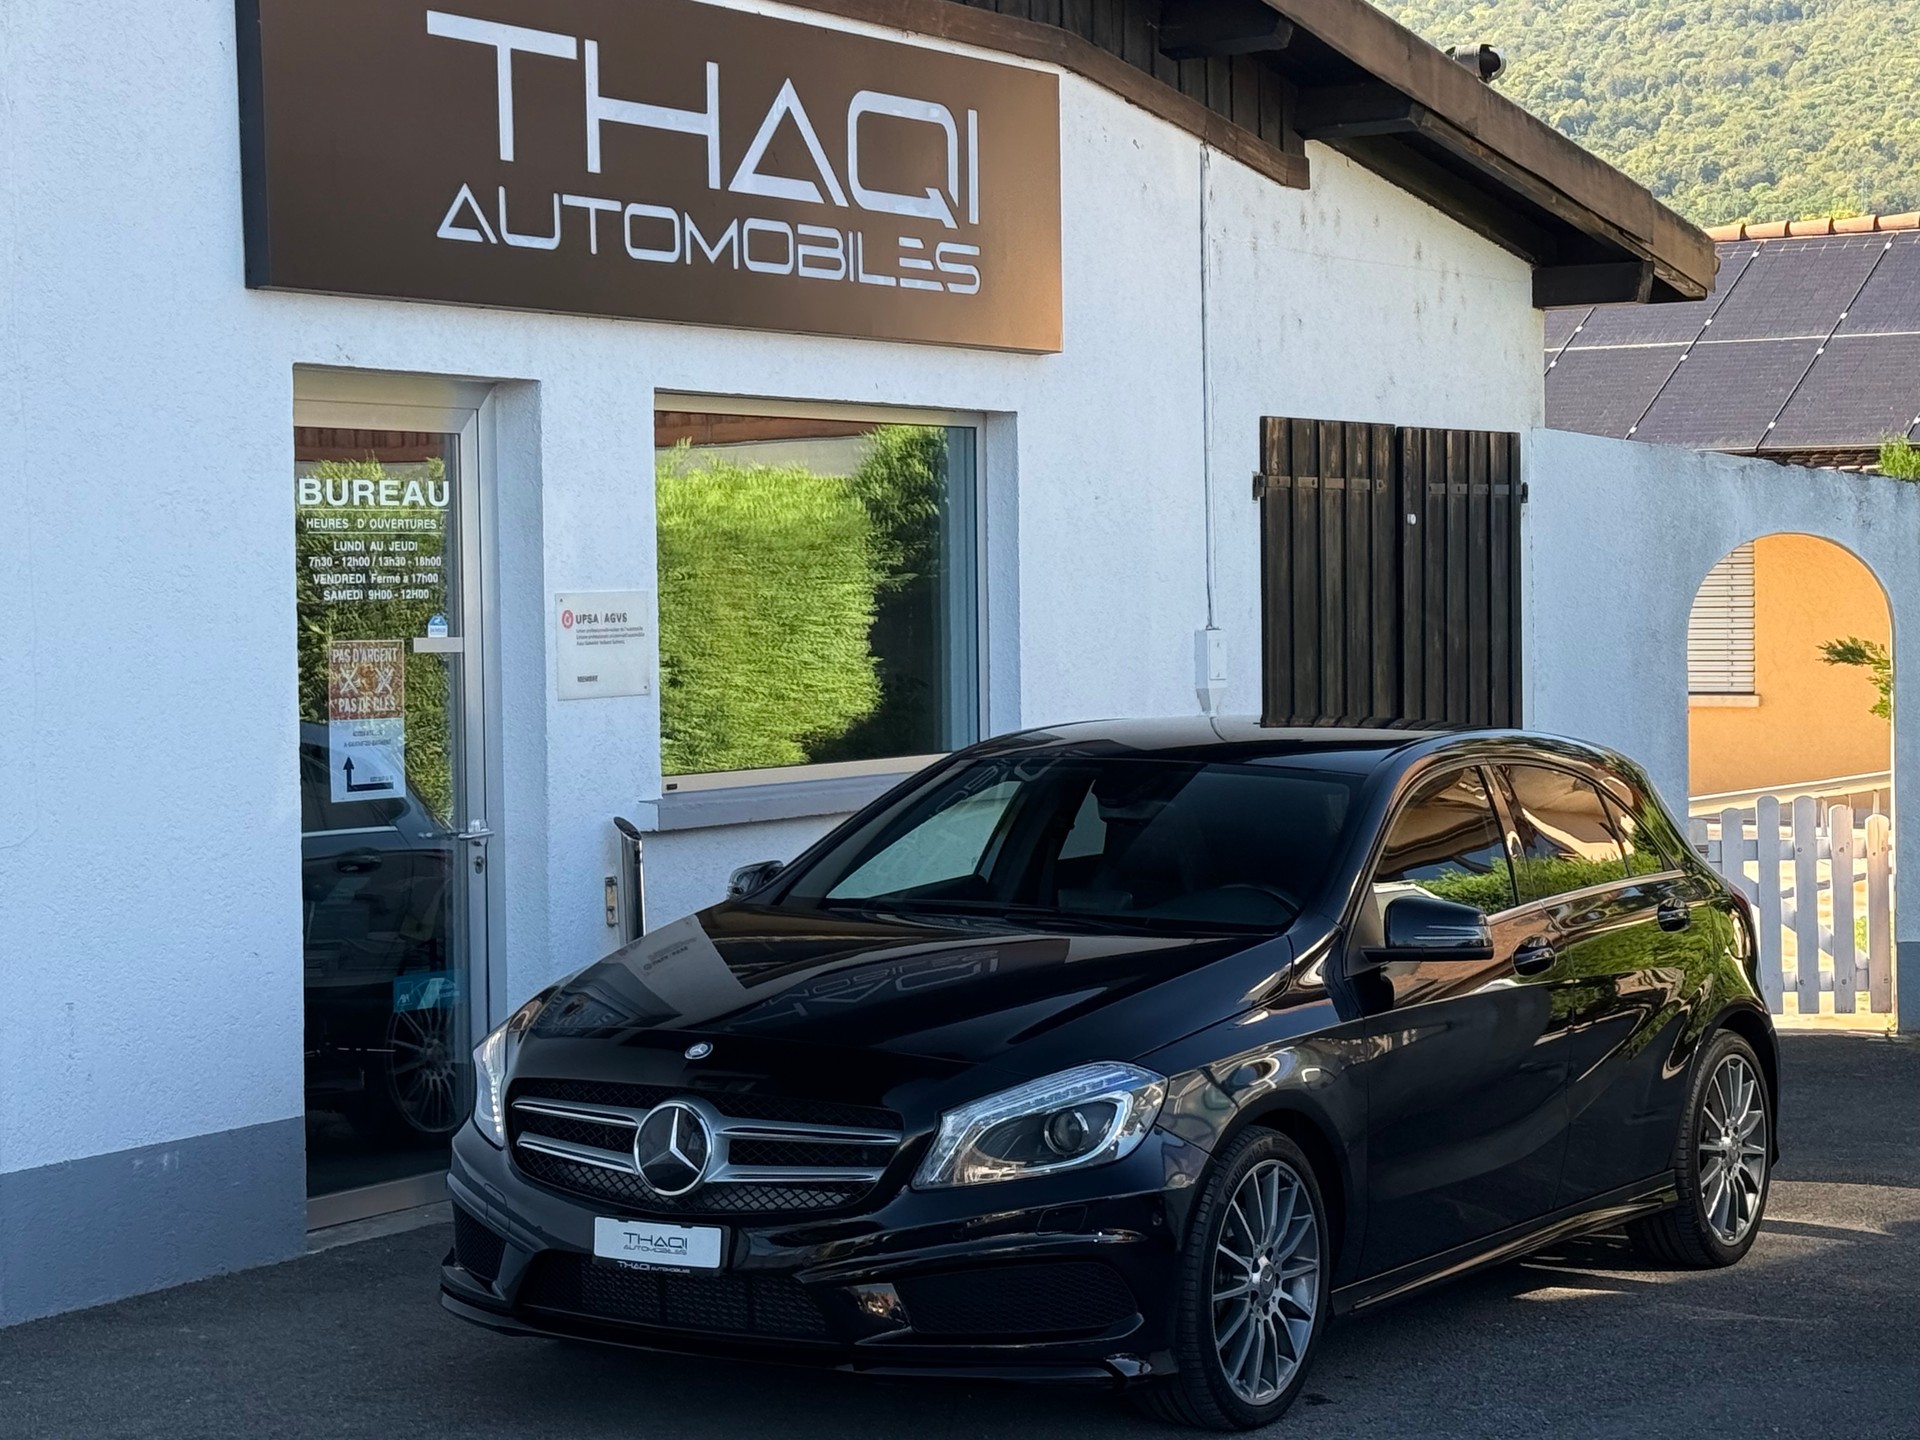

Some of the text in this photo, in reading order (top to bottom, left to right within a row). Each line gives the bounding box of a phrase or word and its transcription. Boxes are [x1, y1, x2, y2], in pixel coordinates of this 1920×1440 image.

[426, 10, 980, 230] THAQI
[436, 183, 981, 296] AUTOMOBILES
[298, 478, 450, 507] BUREAU
[306, 518, 349, 530] HEURES
[333, 541, 418, 551] LUNDI AU JEUDI
[308, 556, 333, 567] 7h30
[342, 556, 370, 567] 12h00
[379, 556, 406, 567] 13h30
[313, 573, 366, 584] VENDREDI
[371, 573, 401, 584] Fermé
[411, 573, 439, 583] 17h00
[323, 590, 364, 600] SAMEDI
[368, 590, 393, 600] 9H00
[401, 590, 430, 600] 12H00
[575, 612, 628, 624] UPSA AGVS
[332, 649, 351, 663] PAS
[338, 698, 357, 712] PAS
[623, 1232, 688, 1249] THAQI
[617, 1260, 650, 1271] THAQI
